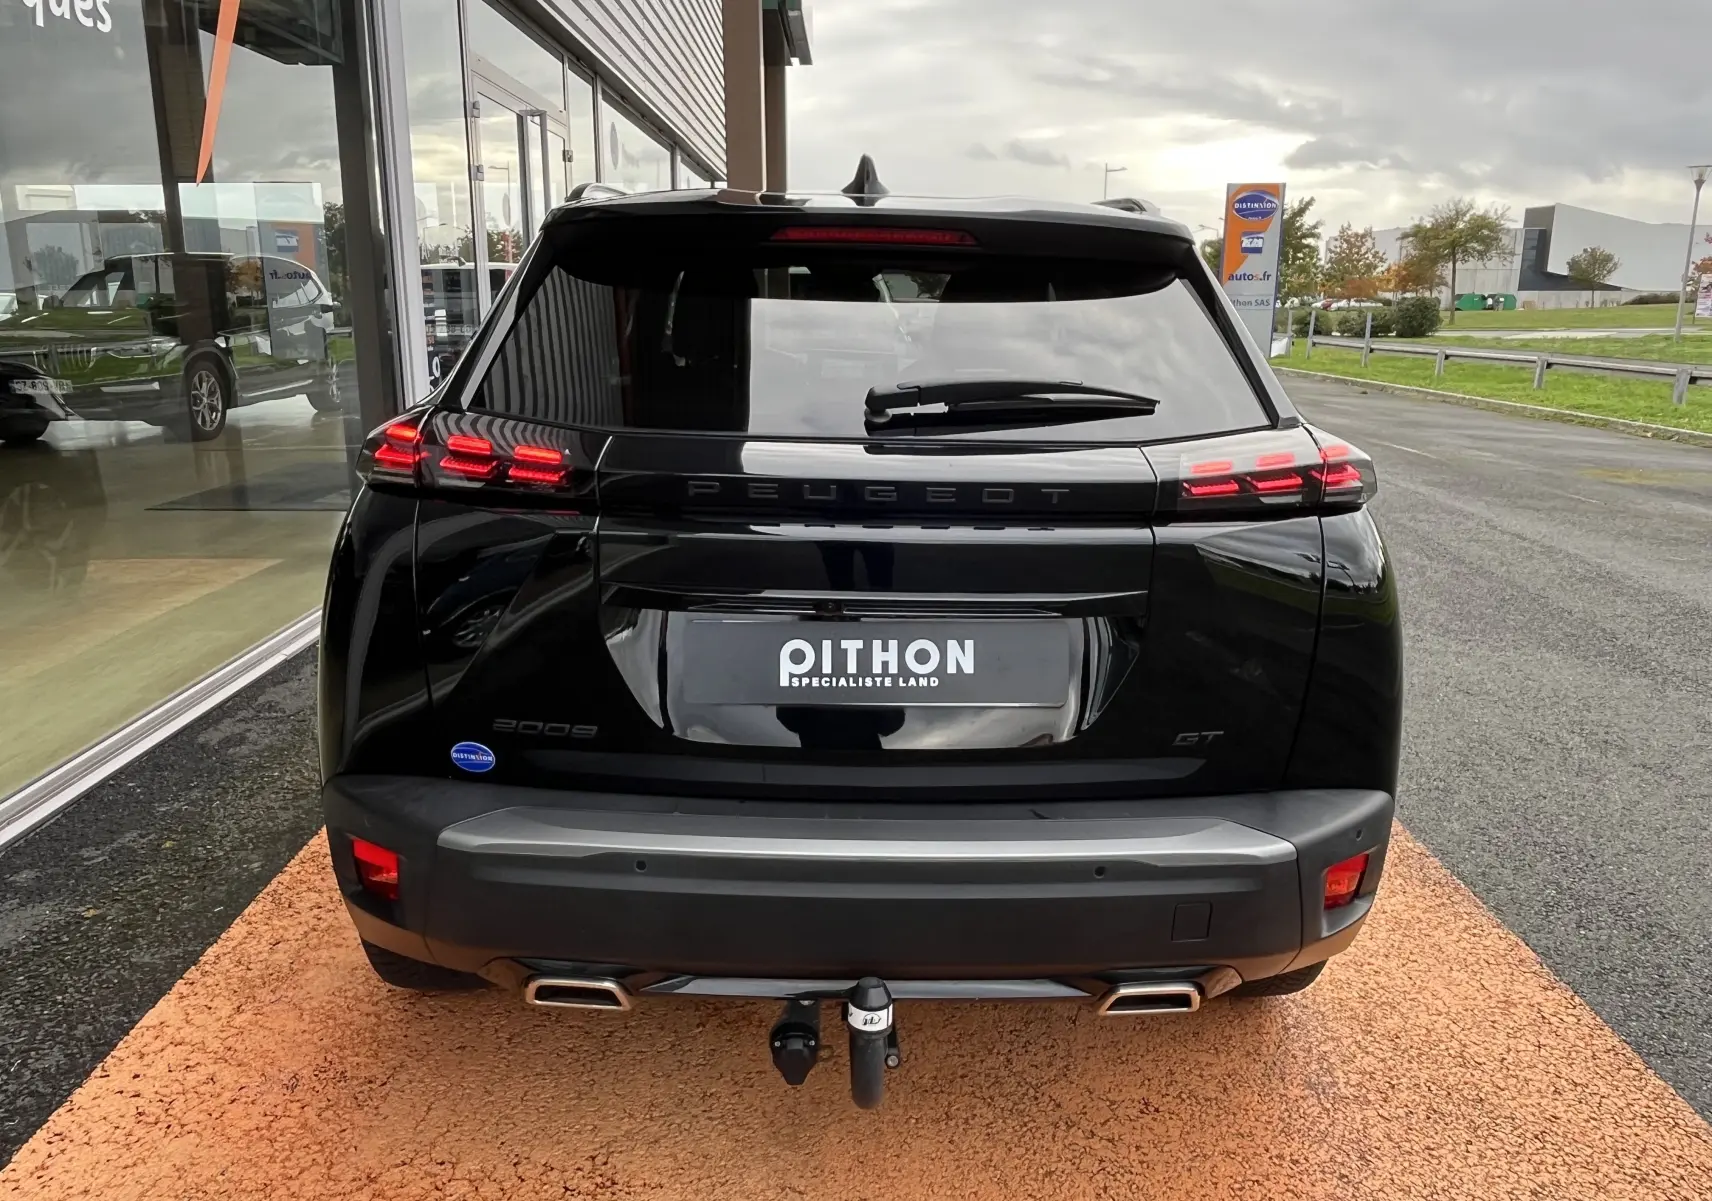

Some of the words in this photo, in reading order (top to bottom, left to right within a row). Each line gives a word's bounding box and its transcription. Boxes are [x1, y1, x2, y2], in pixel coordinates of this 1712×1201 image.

[1254, 299, 1271, 307] SAS
[688, 481, 1070, 503] PEUGEOT
[779, 638, 975, 687] PITHON
[791, 676, 893, 687] SPECIALISTE
[898, 676, 940, 687] LAND
[1171, 730, 1225, 747] GT
